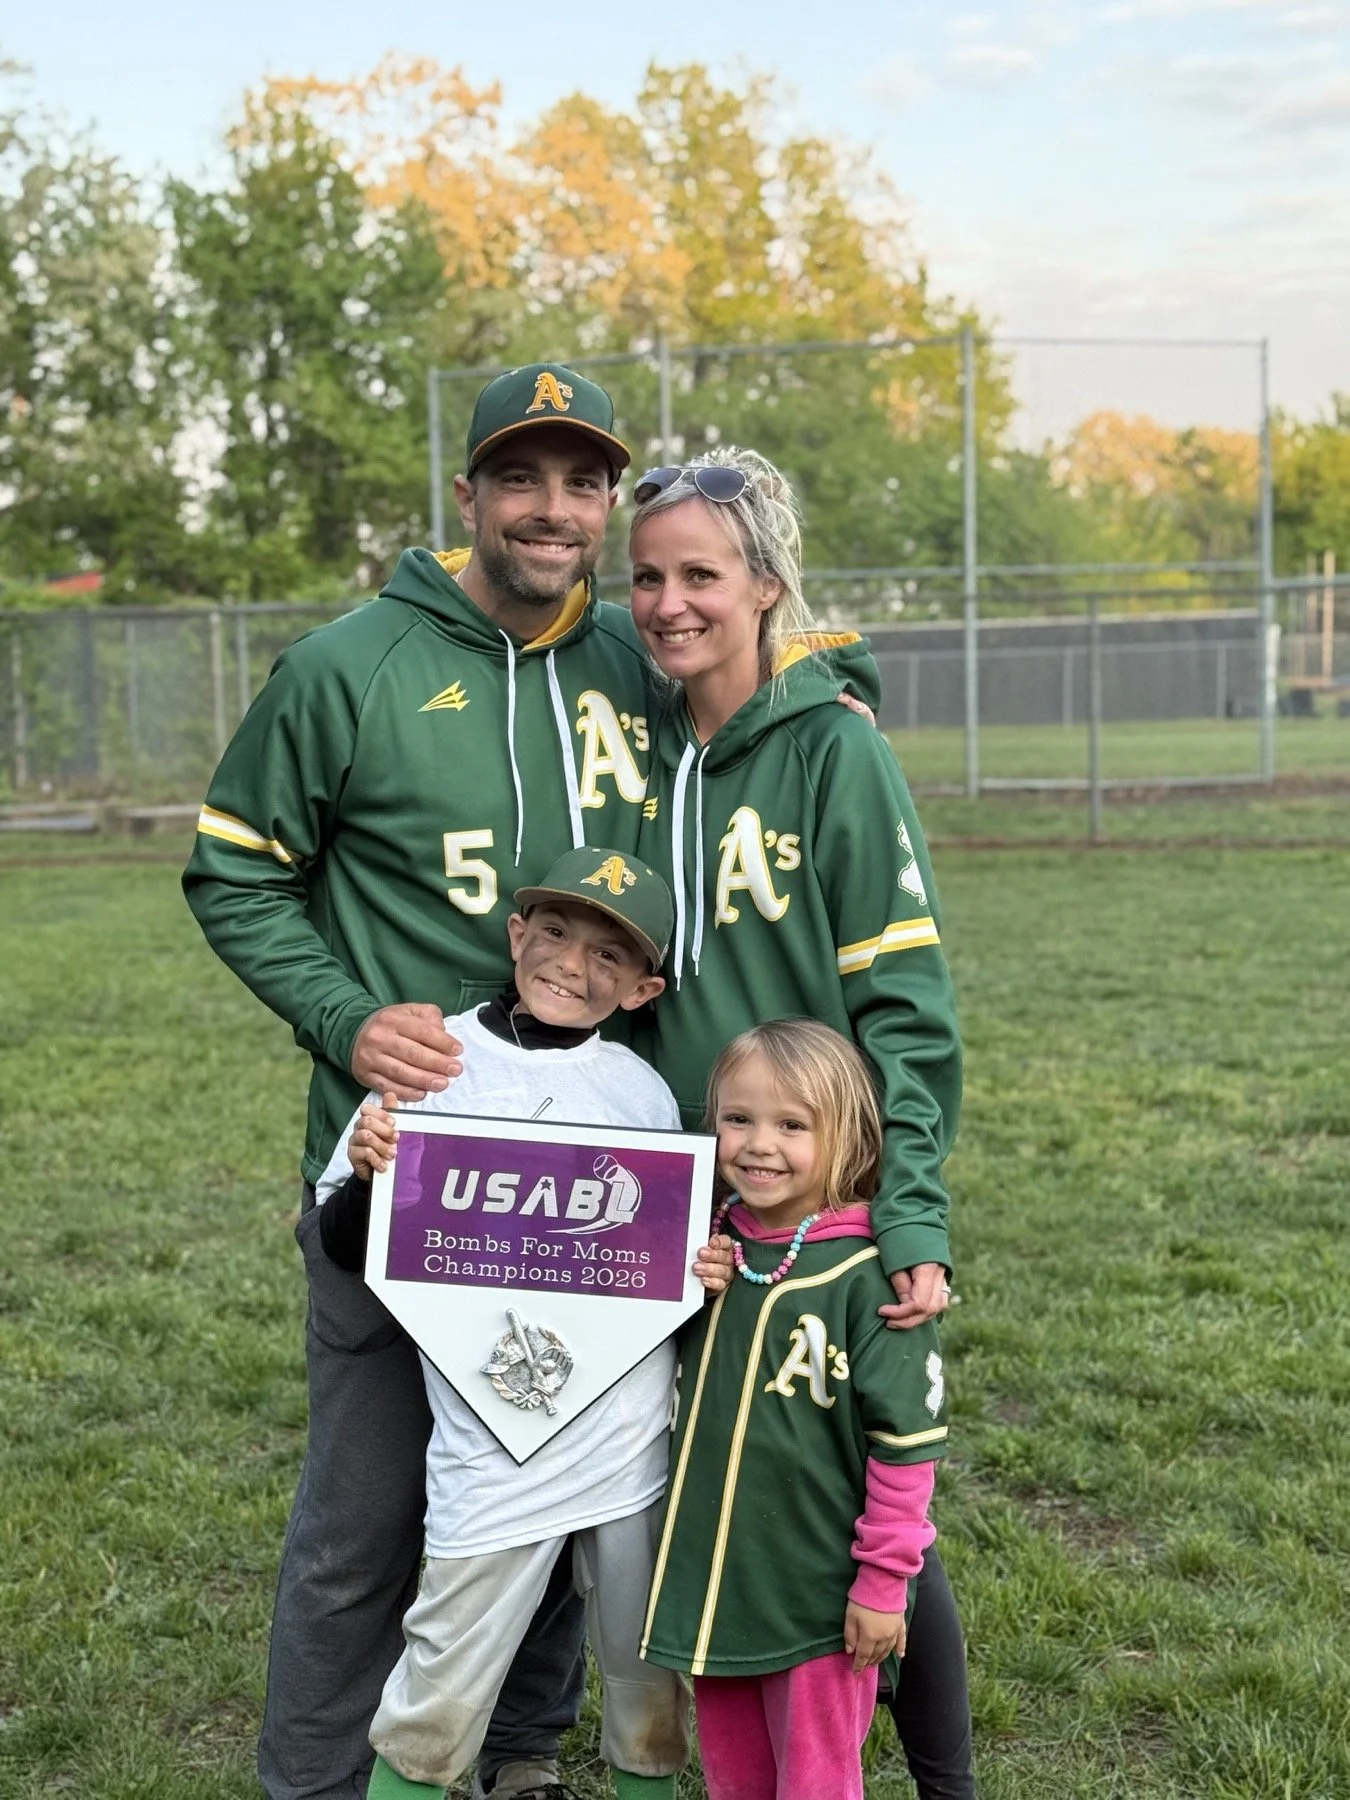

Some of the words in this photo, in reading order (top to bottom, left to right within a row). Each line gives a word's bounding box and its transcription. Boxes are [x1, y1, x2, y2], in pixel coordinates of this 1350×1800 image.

[525, 372, 574, 414] A's
[576, 689, 650, 809] A's
[443, 828, 498, 915] 5
[714, 805, 801, 930] A's
[440, 1168, 638, 1224] USABL
[423, 1229, 511, 1255] Bombs
[520, 1236, 563, 1259] For
[571, 1241, 651, 1265] Moms
[423, 1254, 572, 1284] Champions
[580, 1267, 647, 1289] 2026
[764, 1313, 850, 1409] A's
